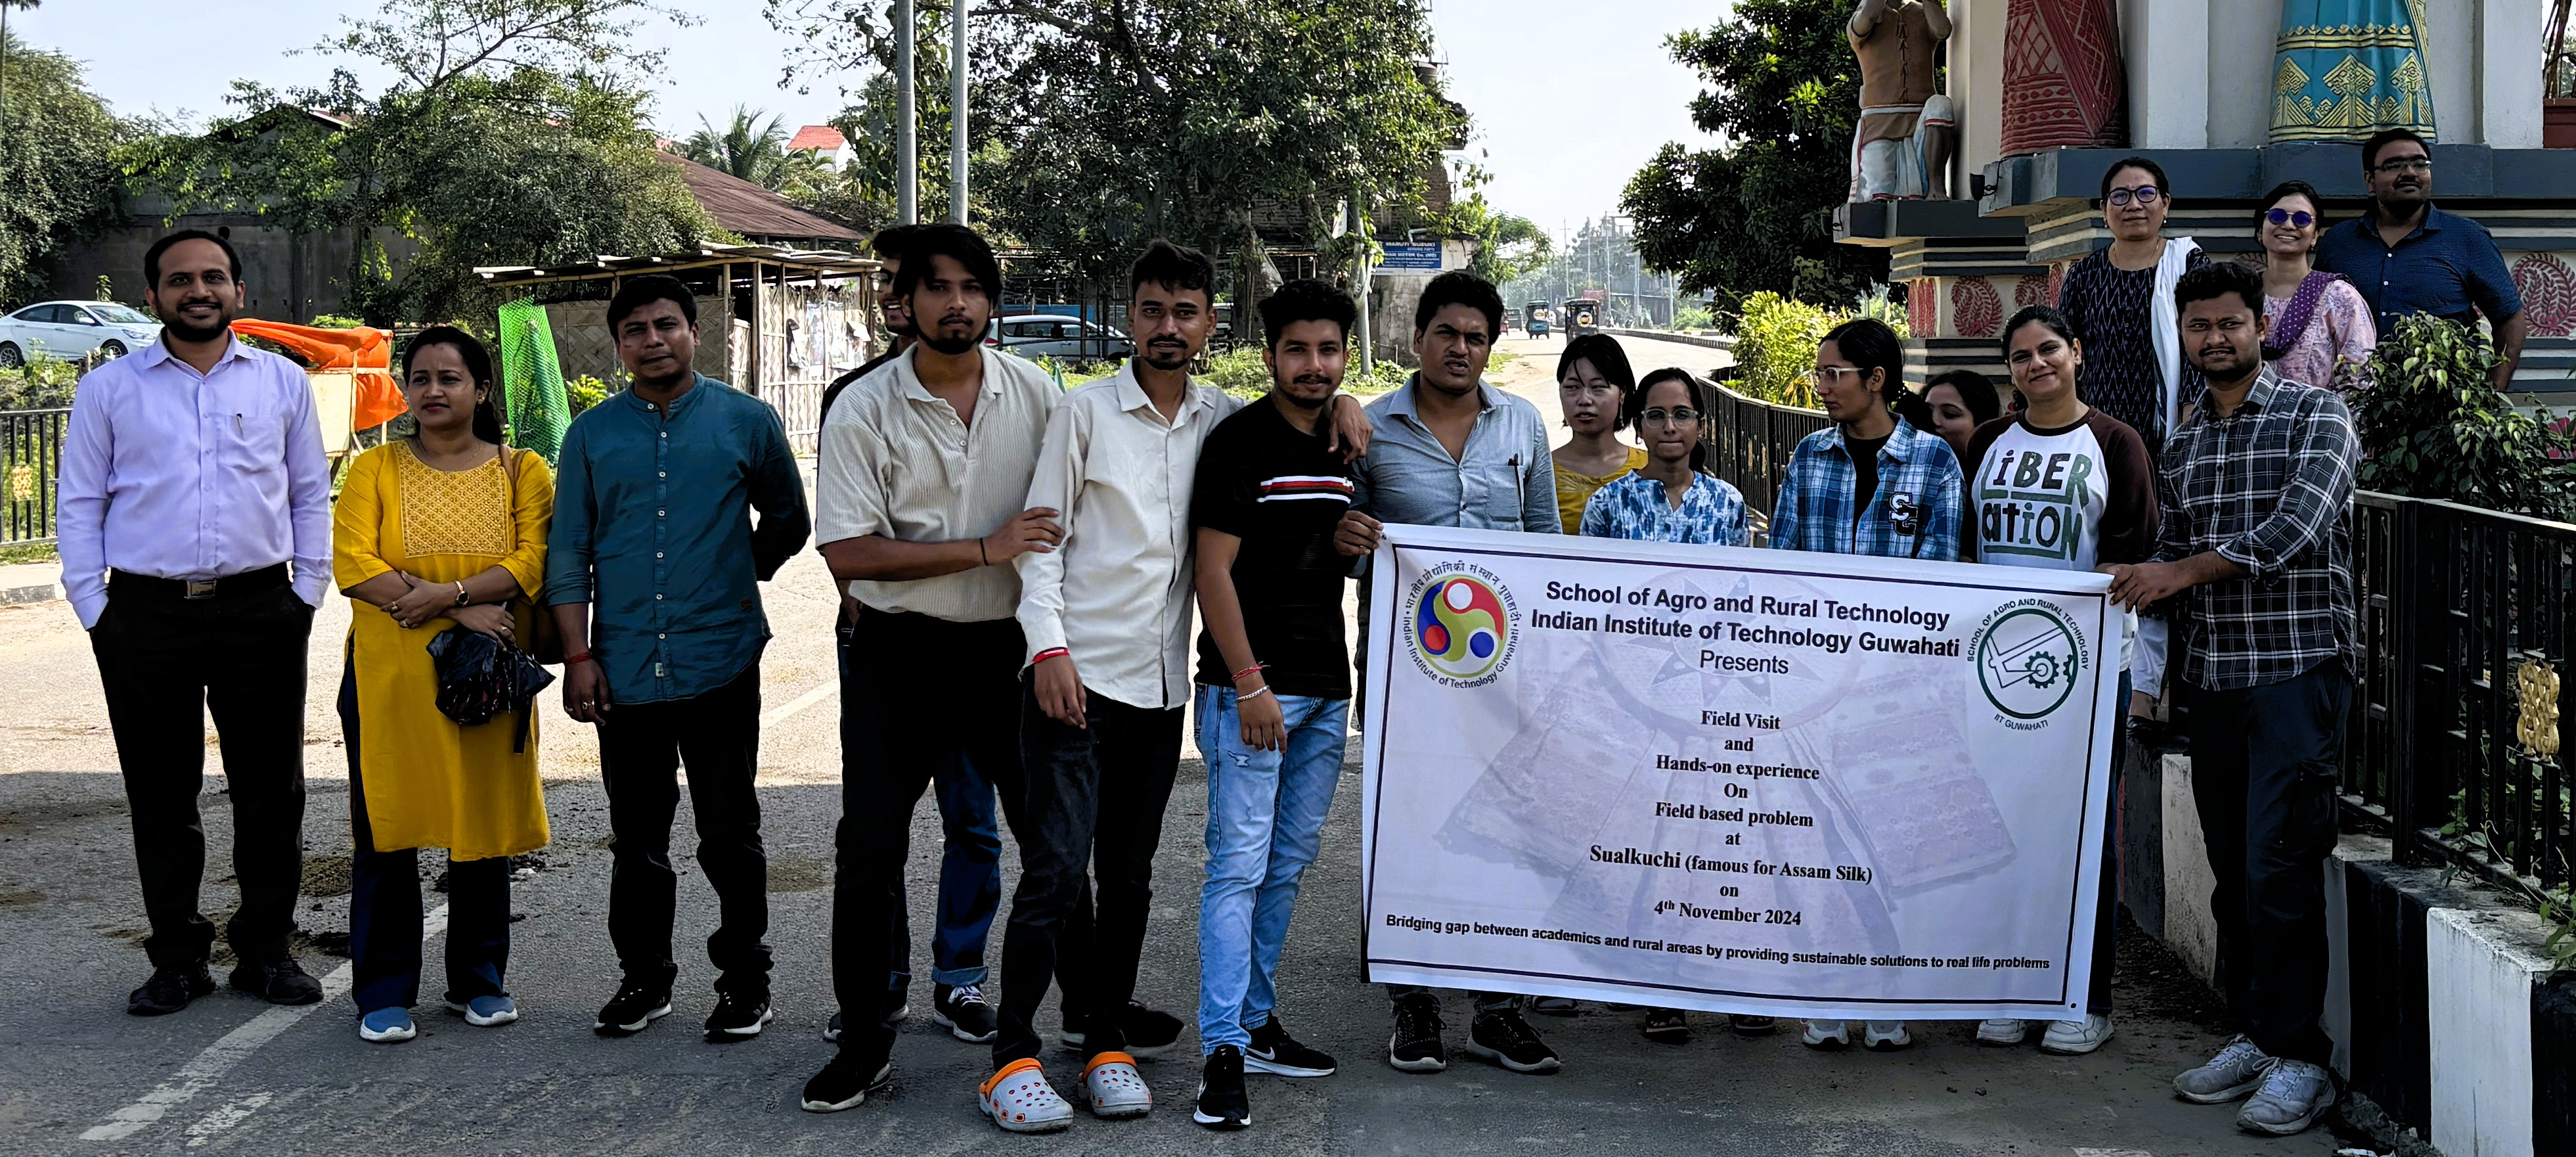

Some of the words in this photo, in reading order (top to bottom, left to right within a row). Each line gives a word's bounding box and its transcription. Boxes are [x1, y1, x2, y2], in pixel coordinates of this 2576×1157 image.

[1546, 581, 1622, 604] School
[1628, 587, 1651, 606] of
[1654, 589, 1707, 613] Agro
[1714, 595, 1753, 613] and
[1760, 596, 1818, 618] Rural
[1824, 600, 1950, 631] Technology
[1532, 608, 1597, 631] Indian
[1605, 614, 1693, 638] Institute
[1699, 622, 1722, 640] of
[1727, 622, 1852, 654] Technology
[1859, 632, 1960, 657] Guwahati
[1967, 628, 1985, 662] SCHOOL
[1982, 614, 1991, 626] OF
[2037, 599, 2062, 616] RURAL
[1403, 616, 1413, 648] Indian
[1408, 647, 1438, 681] Institute
[1438, 677, 1451, 686] of
[1450, 670, 1498, 689] Technology
[1495, 628, 1519, 673] Guwahati
[1700, 649, 1789, 674] Presents
[1701, 710, 1740, 727] Field
[1744, 714, 1781, 729] Visit
[1994, 713, 2005, 723] IIT
[2005, 719, 2049, 731] GUWAHATI
[1724, 737, 1754, 751] and
[1656, 755, 1731, 773] Hands-on
[1736, 763, 1820, 779] experience
[1723, 783, 1748, 798] On
[1655, 802, 1695, 819] Field
[1699, 805, 1743, 822] based
[1748, 810, 1813, 827] problem
[1725, 833, 1741, 845] at
[1589, 845, 1681, 869] Sualkuchi
[1685, 855, 1748, 874] (famous
[1754, 859, 1777, 875] for
[1779, 861, 1831, 879] Assam
[1836, 865, 1873, 884] Silk)
[1720, 886, 1739, 897] on
[1679, 903, 1761, 923] November
[1764, 909, 1802, 926] 2024
[1386, 914, 1442, 933] Bridging
[1445, 922, 1470, 935] gap
[1473, 922, 1528, 937] between
[1532, 928, 1601, 945] academics
[1605, 936, 1629, 947] and
[1633, 940, 1663, 951] rural
[1666, 942, 1703, 955] areas
[1706, 944, 1723, 959] by
[1726, 947, 1788, 964] providing
[1792, 952, 1867, 966] sustainable
[1870, 955, 1928, 967] solutions
[1931, 957, 1943, 967] to
[1946, 957, 1969, 968] real
[1972, 957, 1990, 968] life
[1993, 957, 2050, 970] problems
